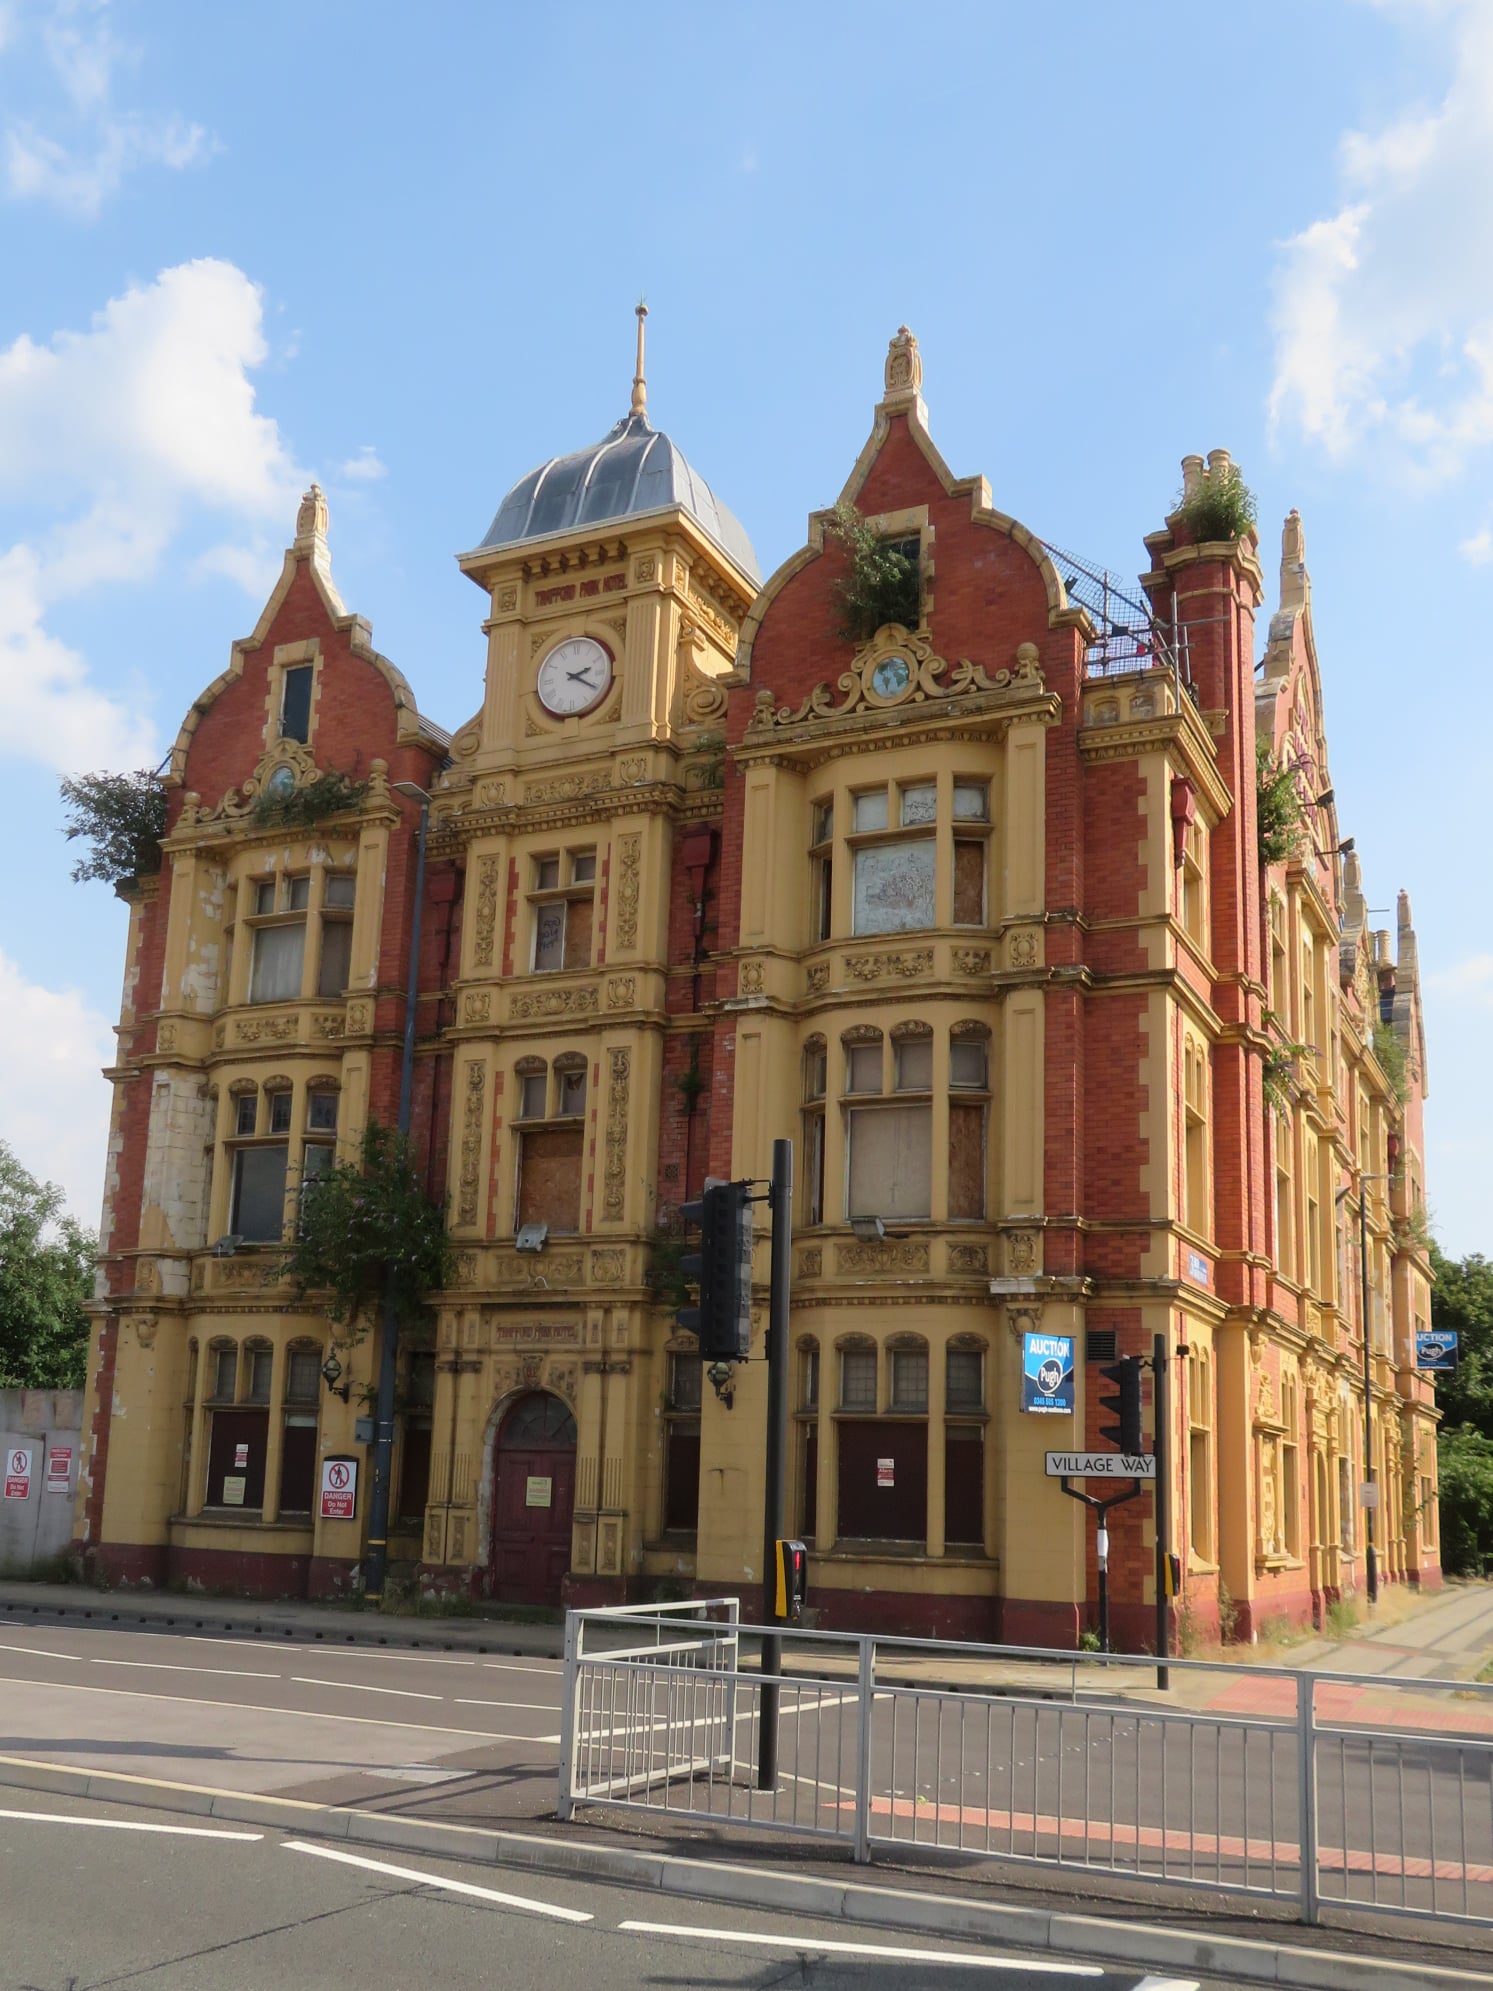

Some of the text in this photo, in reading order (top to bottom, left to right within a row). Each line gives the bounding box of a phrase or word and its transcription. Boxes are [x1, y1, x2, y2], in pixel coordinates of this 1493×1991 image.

[535, 572, 627, 607] TRAFFORD PARK HOTEL
[1416, 1333, 1453, 1341] UCTION
[1029, 1338, 1070, 1358] AUCTION
[1421, 1346, 1441, 1357] Pugh
[1040, 1366, 1059, 1387] Pugh
[1052, 1457, 1153, 1473] VILLAGE WAY
[324, 1492, 352, 1500] DANGER
